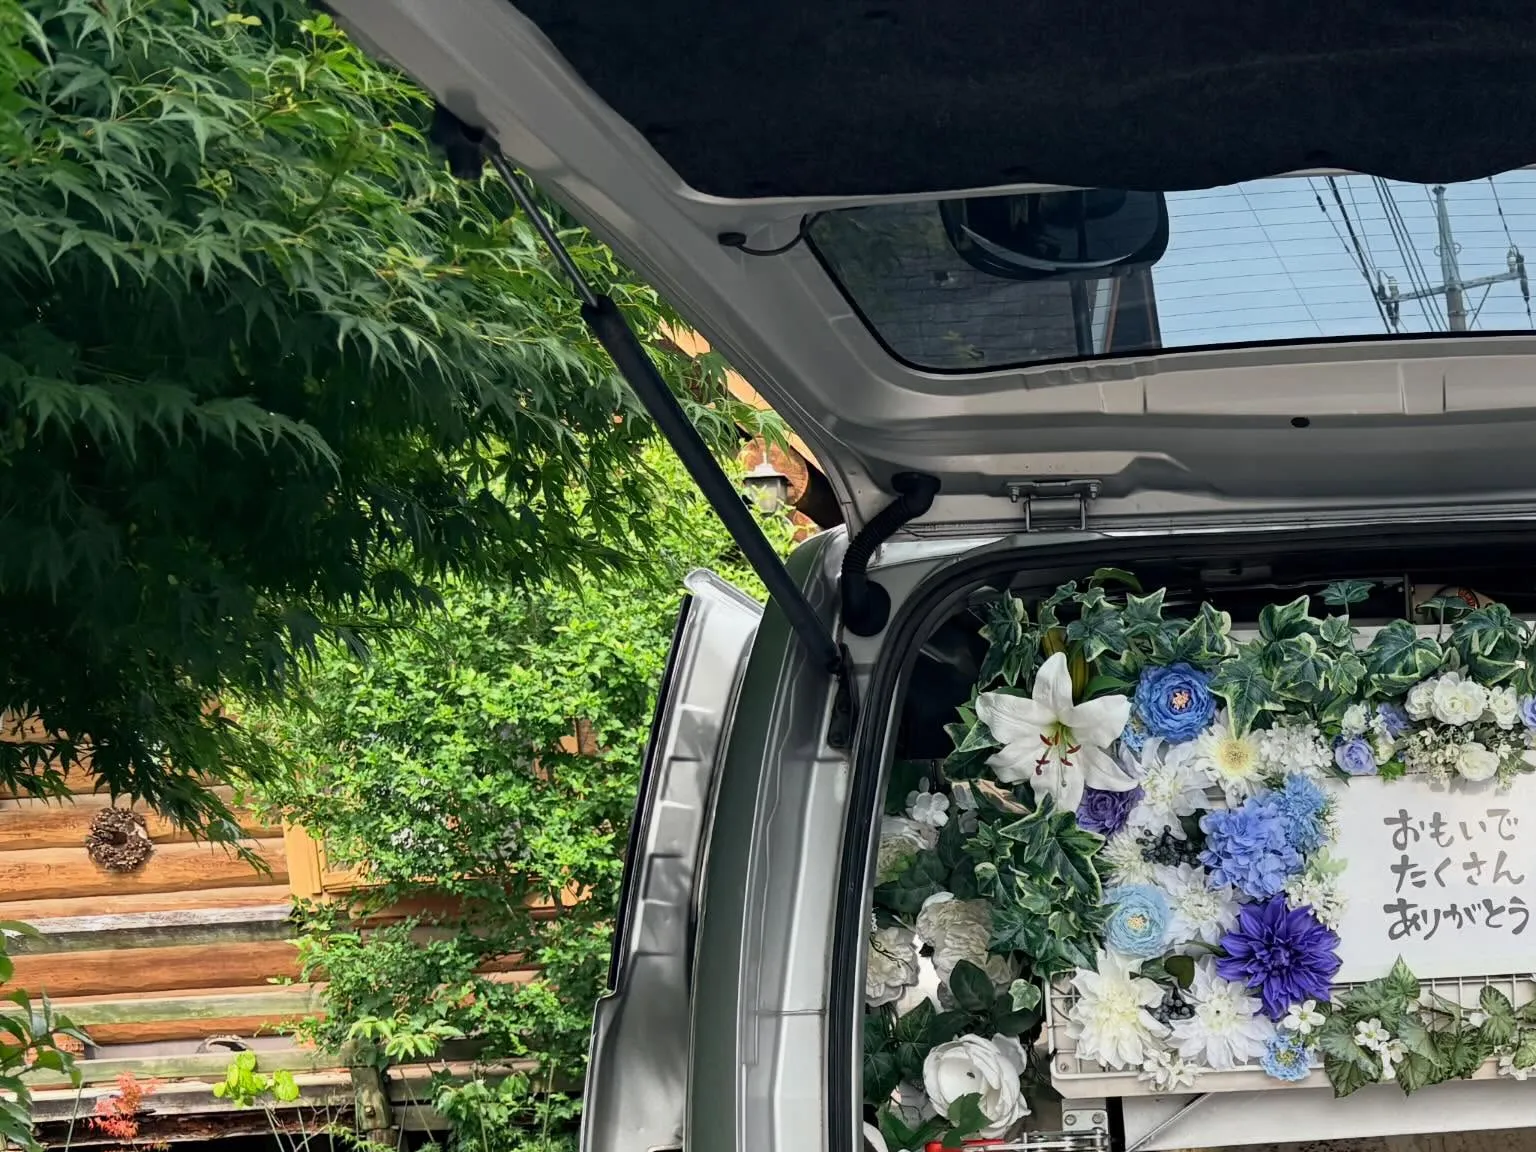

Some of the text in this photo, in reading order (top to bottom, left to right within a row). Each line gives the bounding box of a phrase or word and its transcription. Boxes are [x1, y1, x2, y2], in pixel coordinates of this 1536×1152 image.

[1383, 808, 1519, 851] おもいで
[1390, 850, 1525, 894] たくさん
[1383, 896, 1530, 941] ありがとう
